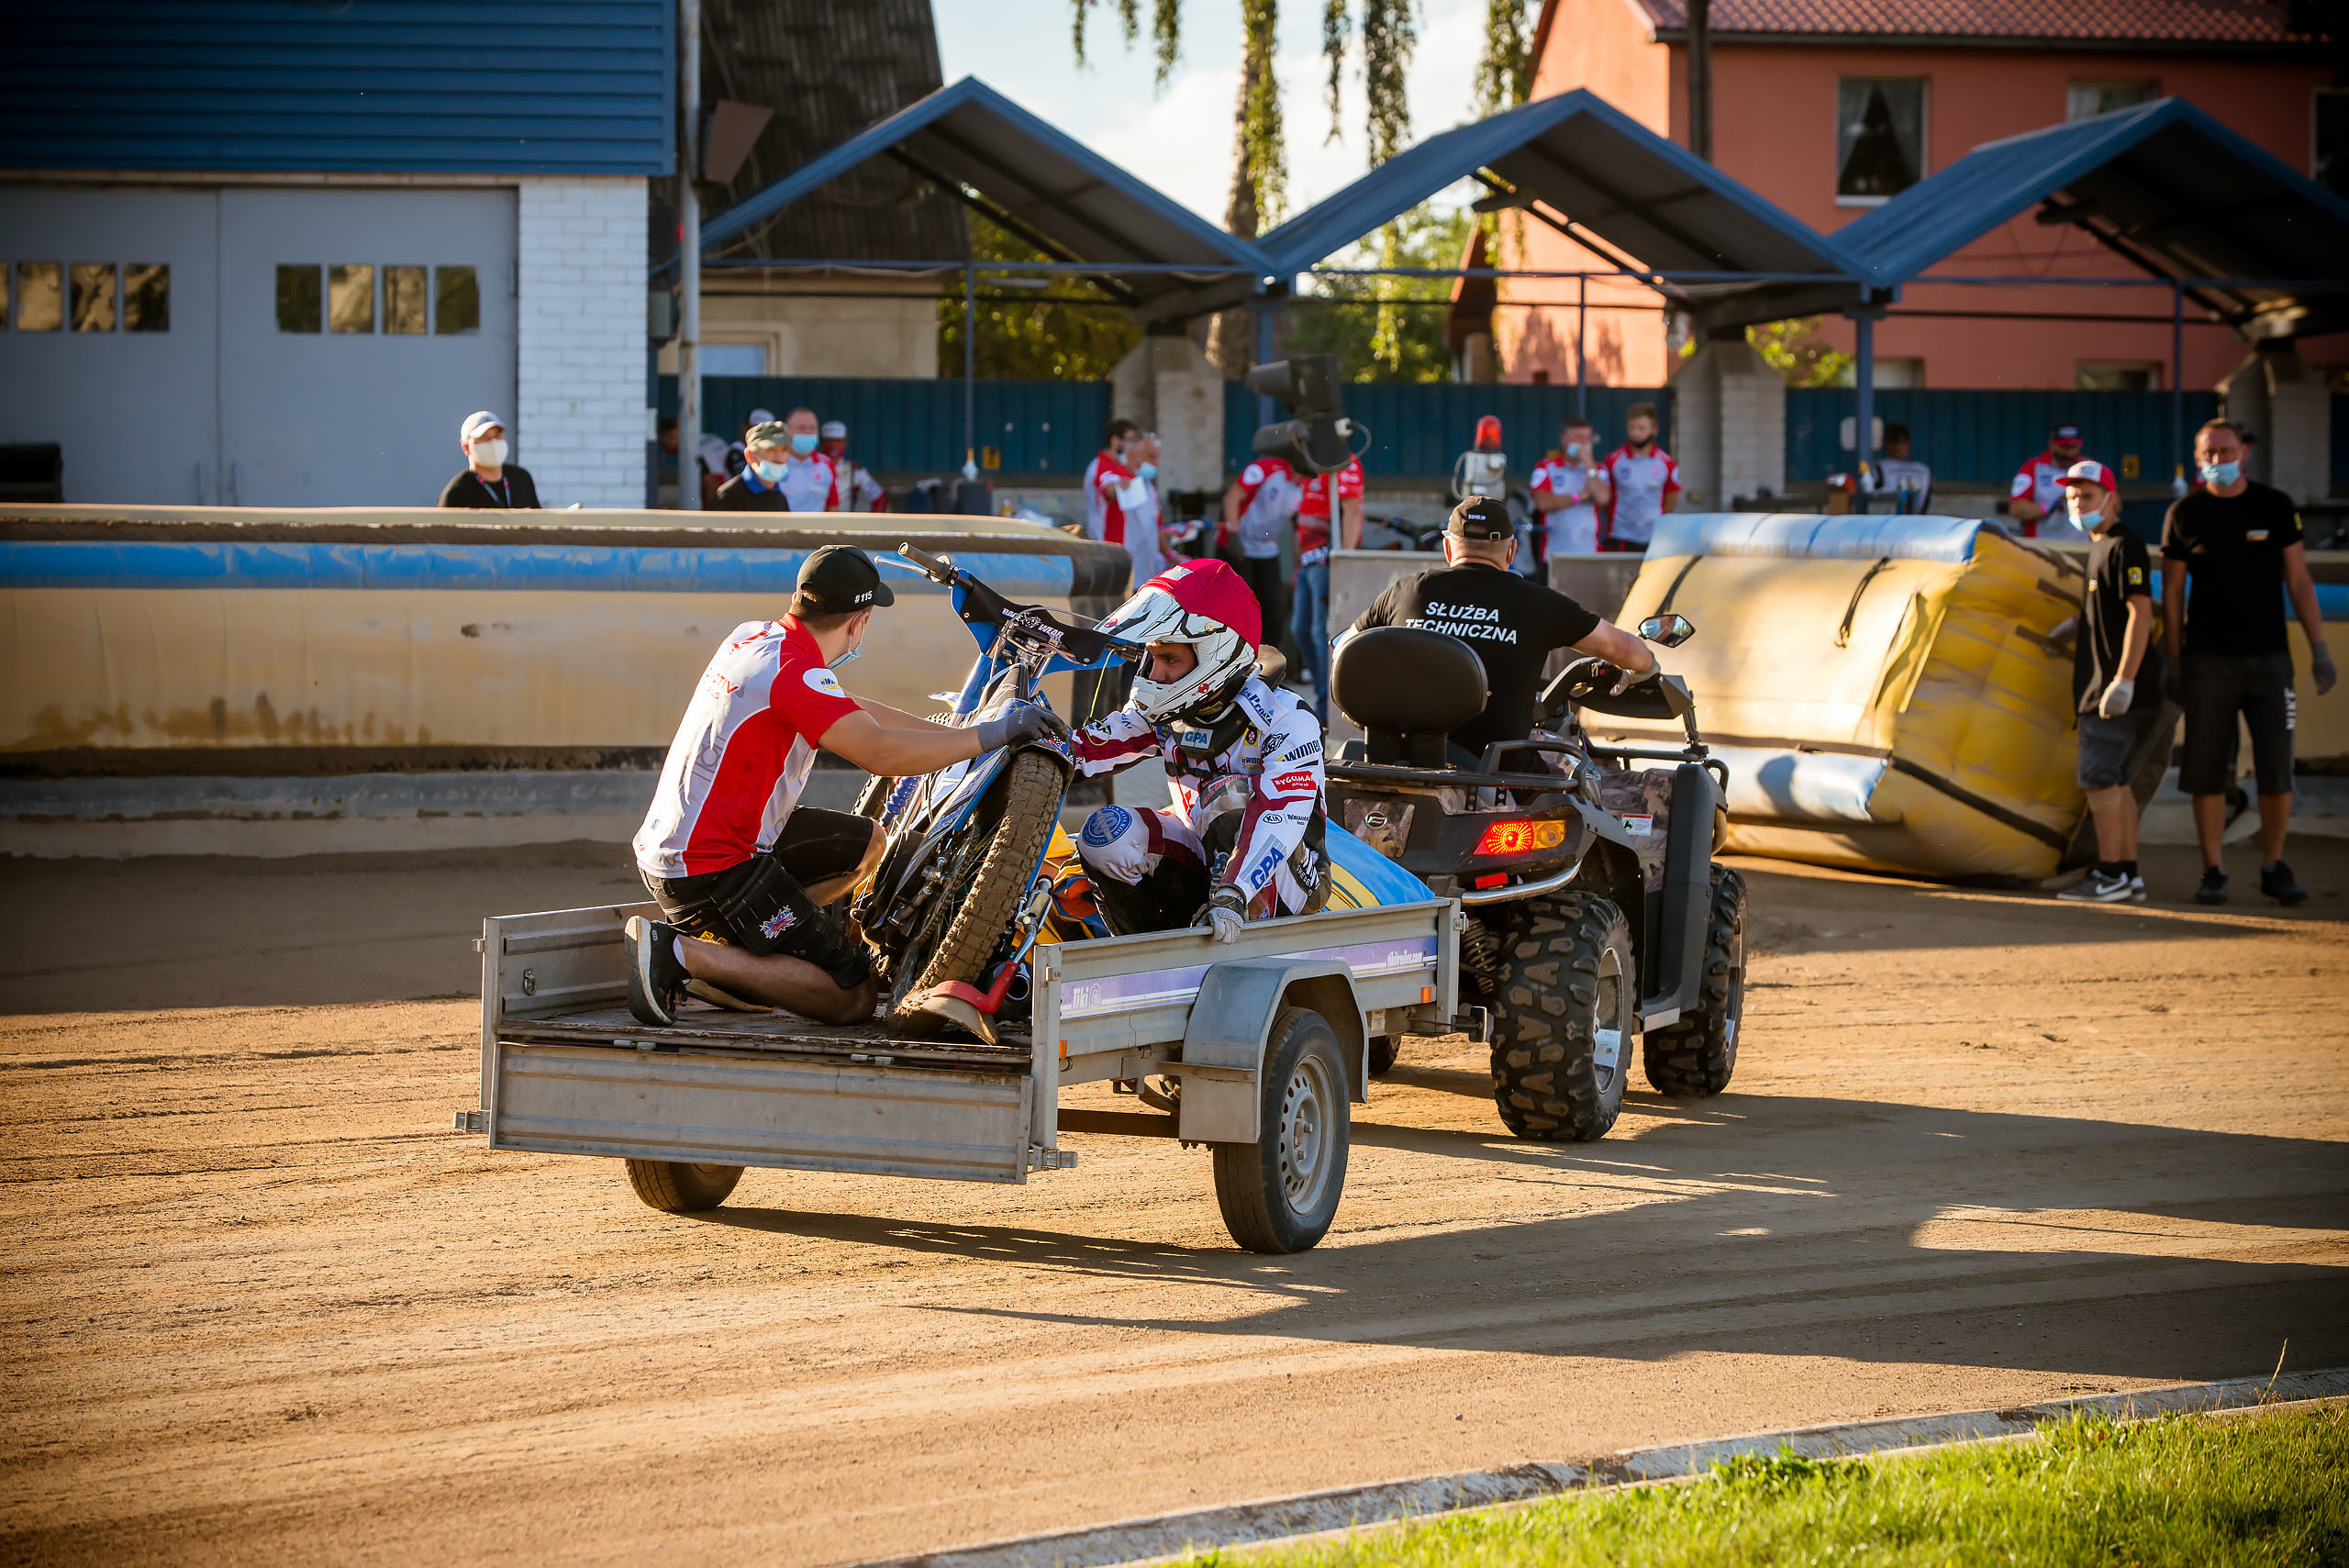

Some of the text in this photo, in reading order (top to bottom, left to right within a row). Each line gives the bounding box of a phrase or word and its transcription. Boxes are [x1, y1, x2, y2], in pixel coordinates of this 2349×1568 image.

[854, 590, 873, 604] #115
[1425, 601, 1499, 622] SŁUŻBA
[1405, 618, 1517, 644] TECHNICZNA
[1184, 731, 1208, 744] GPA
[1251, 847, 1285, 890] GPA
